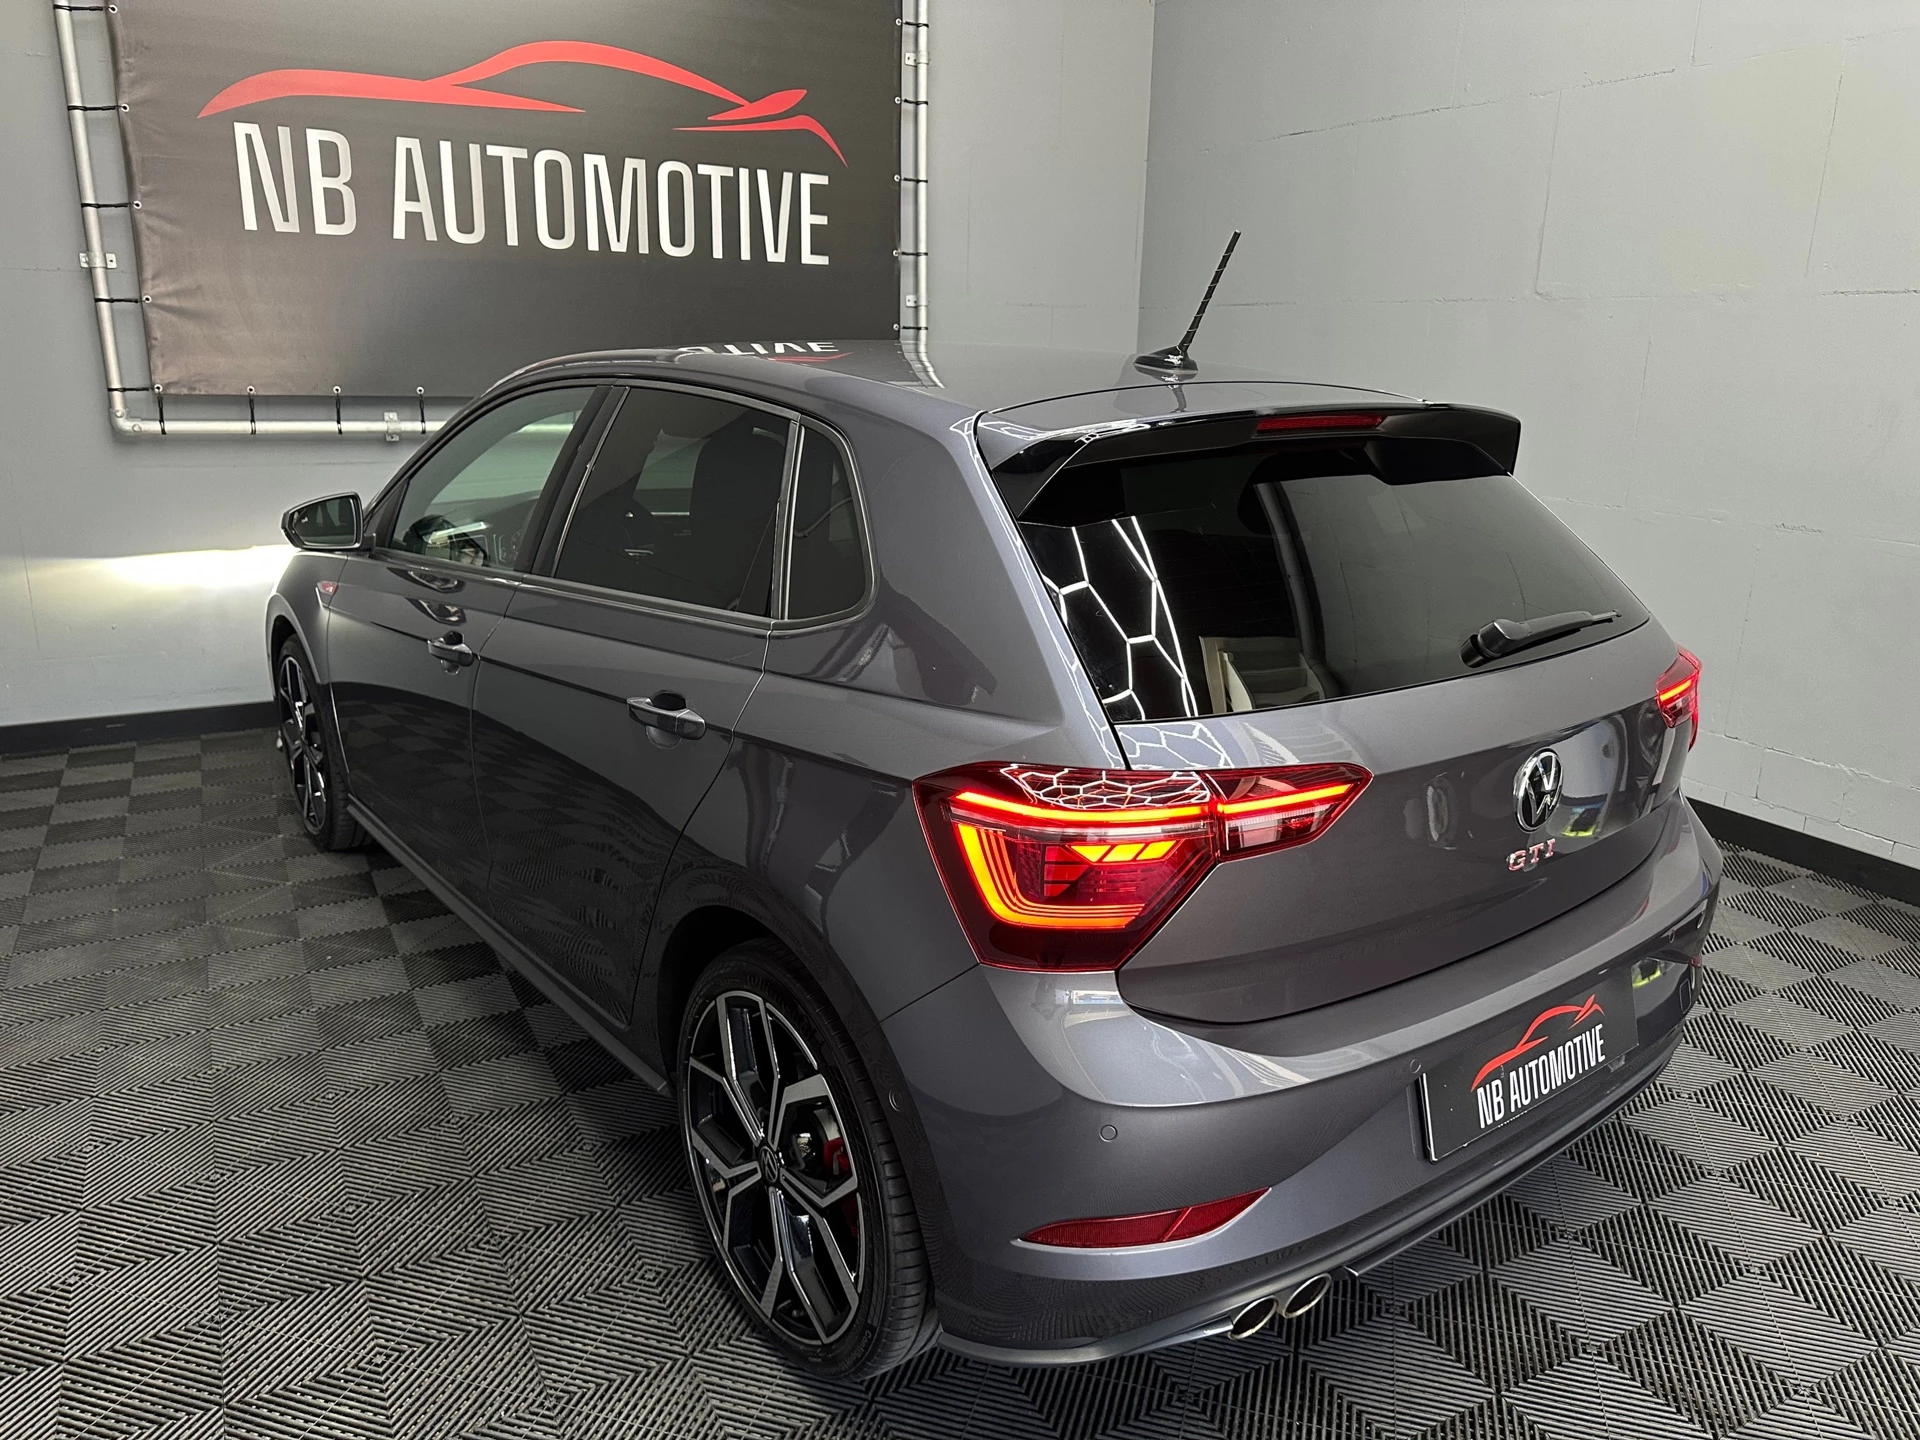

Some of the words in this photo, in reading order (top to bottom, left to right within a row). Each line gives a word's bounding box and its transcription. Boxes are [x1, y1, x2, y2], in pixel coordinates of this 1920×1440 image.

[233, 121, 357, 237] NB
[392, 136, 830, 267] AUTOMOTIVE
[1508, 838, 1556, 871] GTI
[1476, 1079, 1505, 1129] NB
[1509, 1023, 1606, 1113] AUTOMOTIVE
